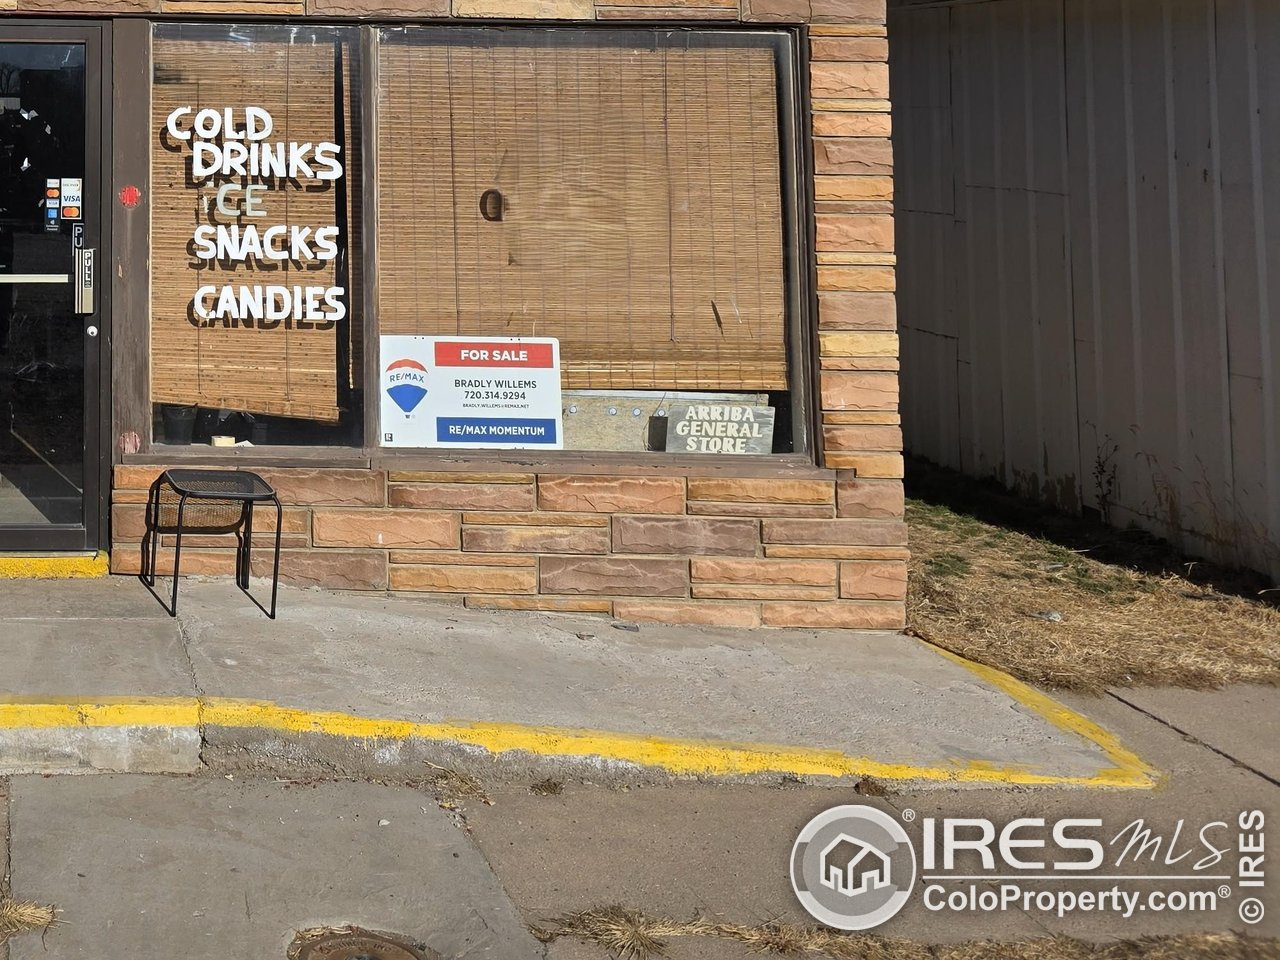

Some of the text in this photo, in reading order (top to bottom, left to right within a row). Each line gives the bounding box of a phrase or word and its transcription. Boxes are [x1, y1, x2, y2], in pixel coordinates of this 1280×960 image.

[166, 106, 274, 141] COLD
[191, 141, 343, 180] DRINKS
[193, 224, 340, 261] SNACKS
[193, 285, 347, 321] CANDIES
[460, 349, 528, 361] FOR SALE
[389, 373, 424, 383] RE/MAX
[454, 379, 537, 389] BRADLY WILLEMS
[464, 391, 526, 400] 720.314.9294
[685, 405, 755, 422] ARRIBA
[449, 425, 545, 436] RE/MAX MOMENTUM
[675, 421, 763, 438] GENERAL
[685, 436, 747, 453] STORE
